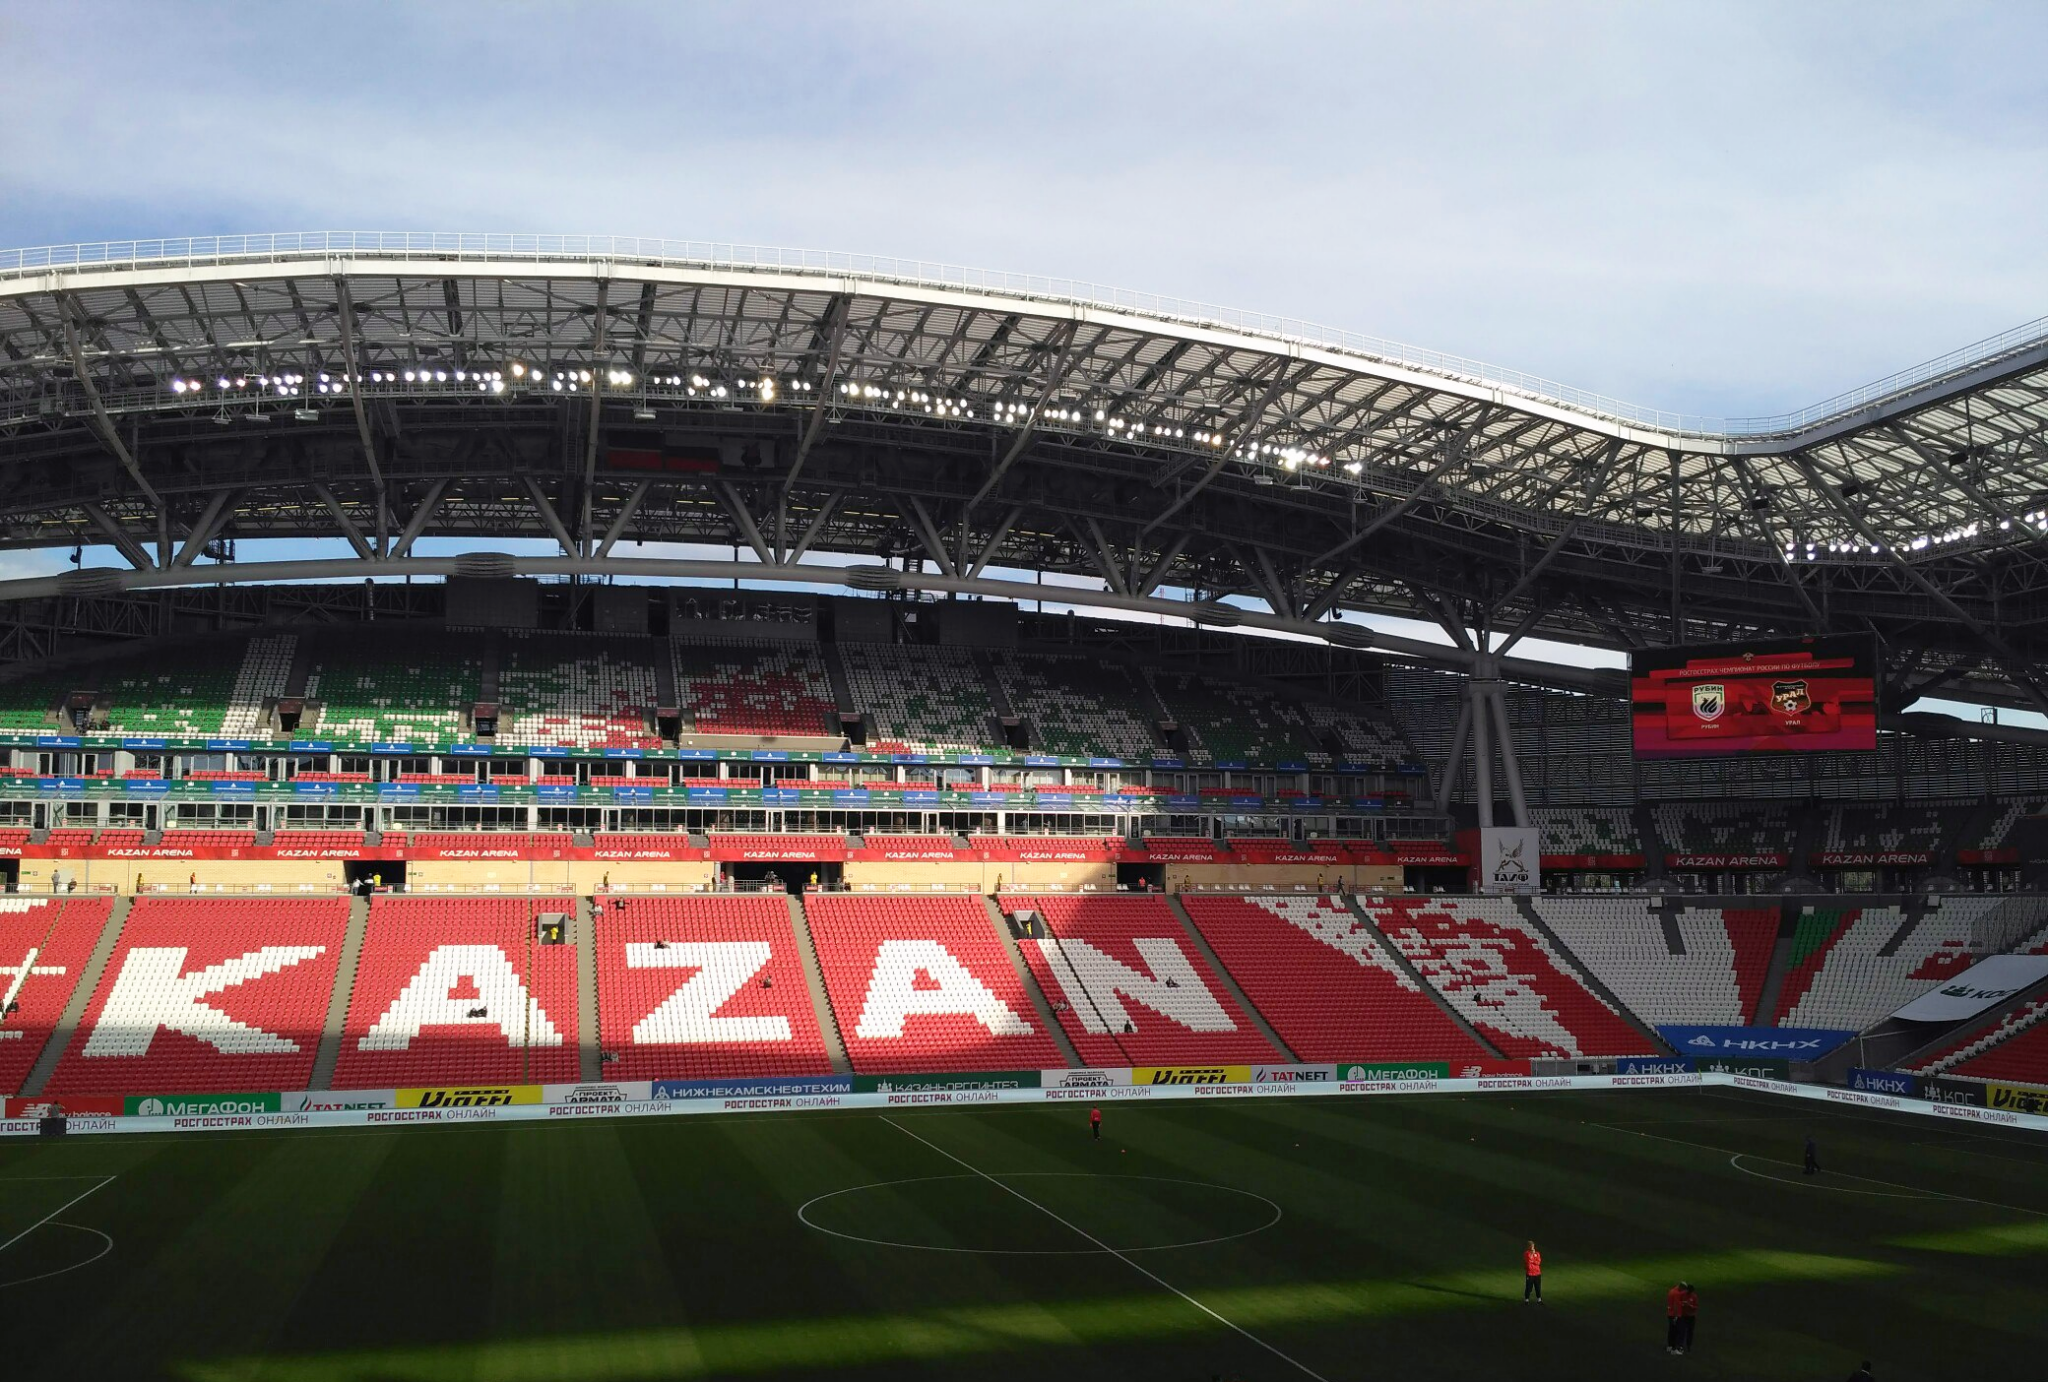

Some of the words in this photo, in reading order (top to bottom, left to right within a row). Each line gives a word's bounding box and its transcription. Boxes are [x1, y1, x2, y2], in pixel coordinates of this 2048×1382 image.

[1775, 688, 1804, 702] УРАЛ
[107, 848, 151, 857] KAZAN
[152, 848, 193, 857] ARENA
[276, 848, 320, 857] KAZAN
[320, 848, 360, 857] ARENA
[439, 850, 479, 858] KAZAN
[481, 850, 519, 858] ARENA
[594, 850, 632, 858] KAZAN
[634, 850, 670, 858] ARENA
[1308, 854, 1338, 862] ARENA
[1676, 857, 1726, 867] KAZAN
[1729, 856, 1778, 866] ARENA
[1822, 855, 1876, 865] KAZAN
[1878, 854, 1928, 864] ARENA
[82, 938, 1238, 1058] KAZAN
[1642, 1063, 1687, 1074] НКНХ
[1271, 1071, 1329, 1082] TATNEFT
[1612, 1076, 1665, 1085] РОСГОССТРАХ
[1668, 1074, 1702, 1084] ОНЛАЙН
[1340, 1083, 1396, 1092] РОСГОССТРАХ
[1400, 1081, 1438, 1090] ОНЛАЙН
[1478, 1080, 1532, 1088] РОСГОССТРАХ
[1536, 1078, 1572, 1088] ОНЛАЙН
[1734, 1076, 1770, 1090] РОСГОССТРАХ
[1771, 1082, 1798, 1093] ОНЛАЙН
[1866, 1077, 1906, 1094] НКНХ
[672, 1084, 850, 1098] НИЖНЕКАМСКНЕФТЕХИМ
[1046, 1089, 1108, 1098] РОСГОССТРАХ
[1110, 1086, 1150, 1096] ОНЛАЙН
[1194, 1086, 1254, 1095] РОСГОССТРАХ
[1256, 1084, 1296, 1094] ОНЛАЙН
[724, 1100, 792, 1109] РОСГОССТРАХ
[796, 1097, 840, 1107] ОНЛАЙН
[888, 1094, 952, 1104] РОСГОССТРАХ
[956, 1092, 998, 1102] ОНЛАЙН
[1826, 1090, 1868, 1103] РОСГОССТРАХ
[1870, 1096, 1900, 1108] ОНЛАЙН
[550, 1105, 621, 1116] РОСГОССТРАХ
[624, 1102, 672, 1112] ОНЛАЙН
[1932, 1104, 1980, 1118] РОСГОССТРАХ
[1983, 1111, 2018, 1124] ОНЛАЙН
[174, 1117, 252, 1128] РОСГОССТРАХ
[257, 1113, 309, 1126] ОНЛАЙН
[367, 1110, 442, 1122] РОСГОССТРАХ
[446, 1108, 496, 1120] ОНЛАЙН
